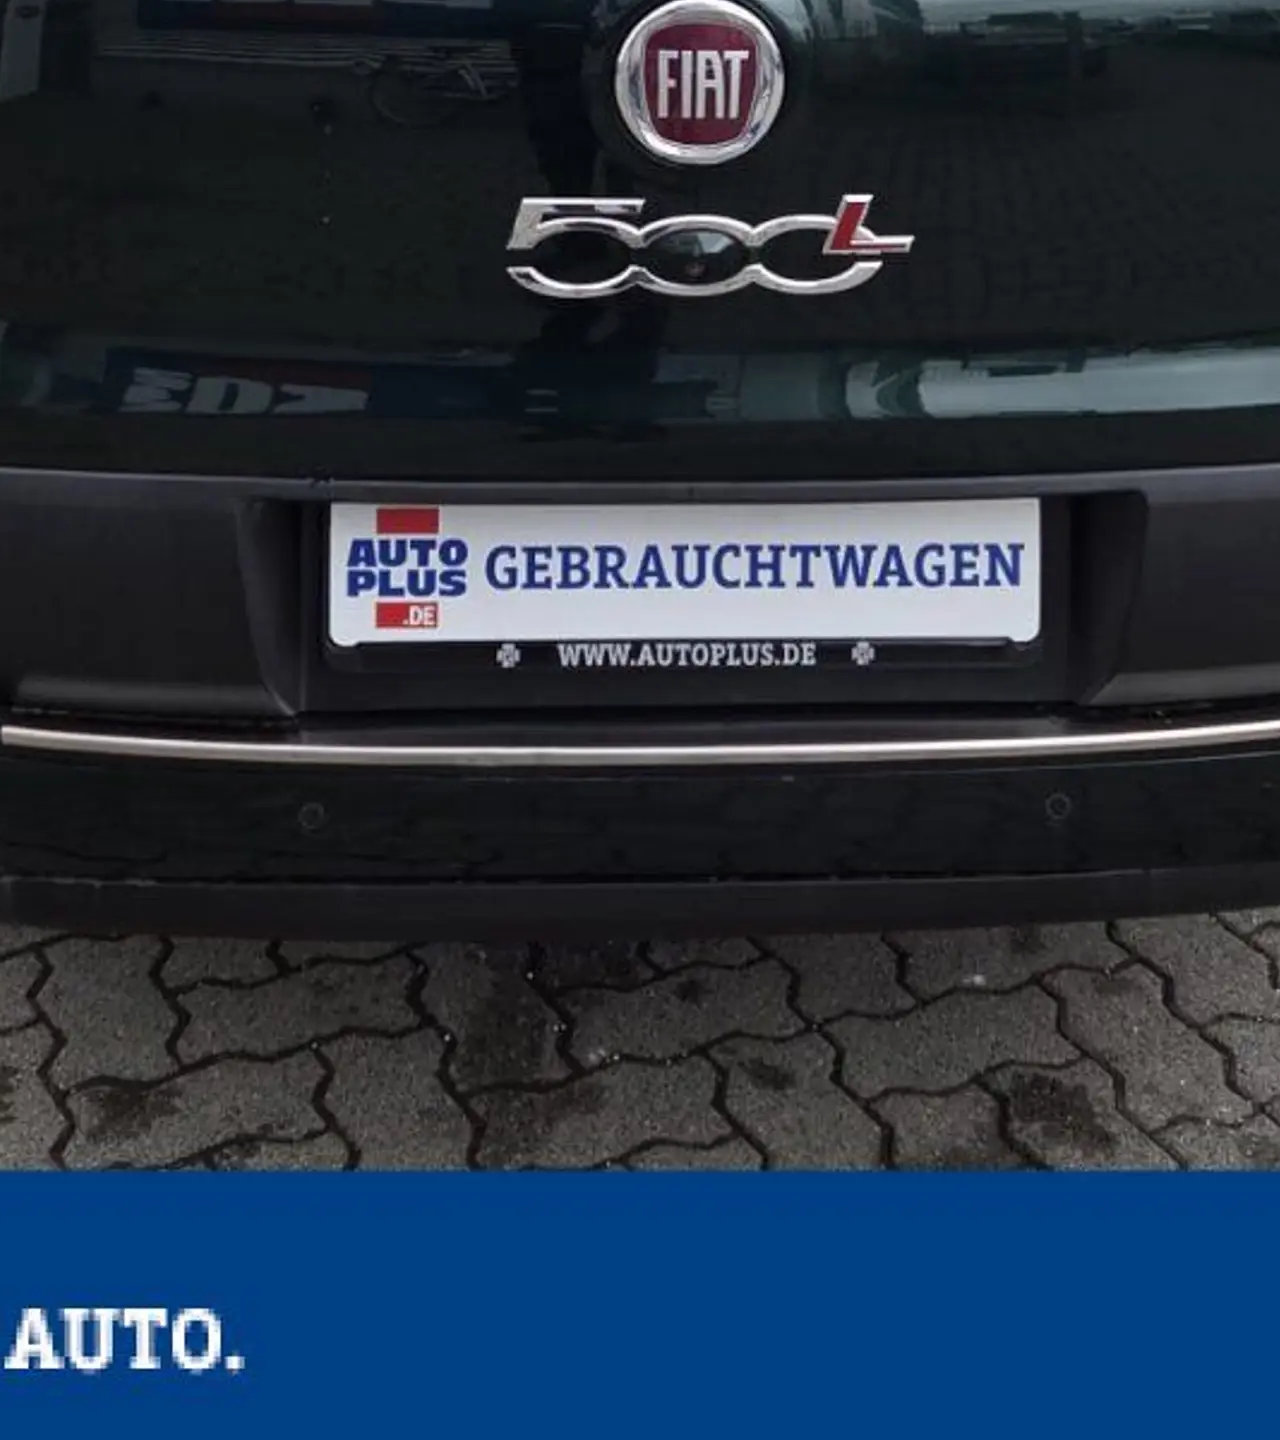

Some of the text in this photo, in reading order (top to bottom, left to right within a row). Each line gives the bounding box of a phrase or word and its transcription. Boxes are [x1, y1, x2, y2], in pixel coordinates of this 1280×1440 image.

[657, 49, 751, 120] FIAT
[347, 537, 469, 568] AUTO
[485, 542, 1025, 590] GEBRAUCHTWAGEN
[347, 569, 468, 598] PLUS
[558, 643, 816, 667] WWW.AUTOPLUS.DE
